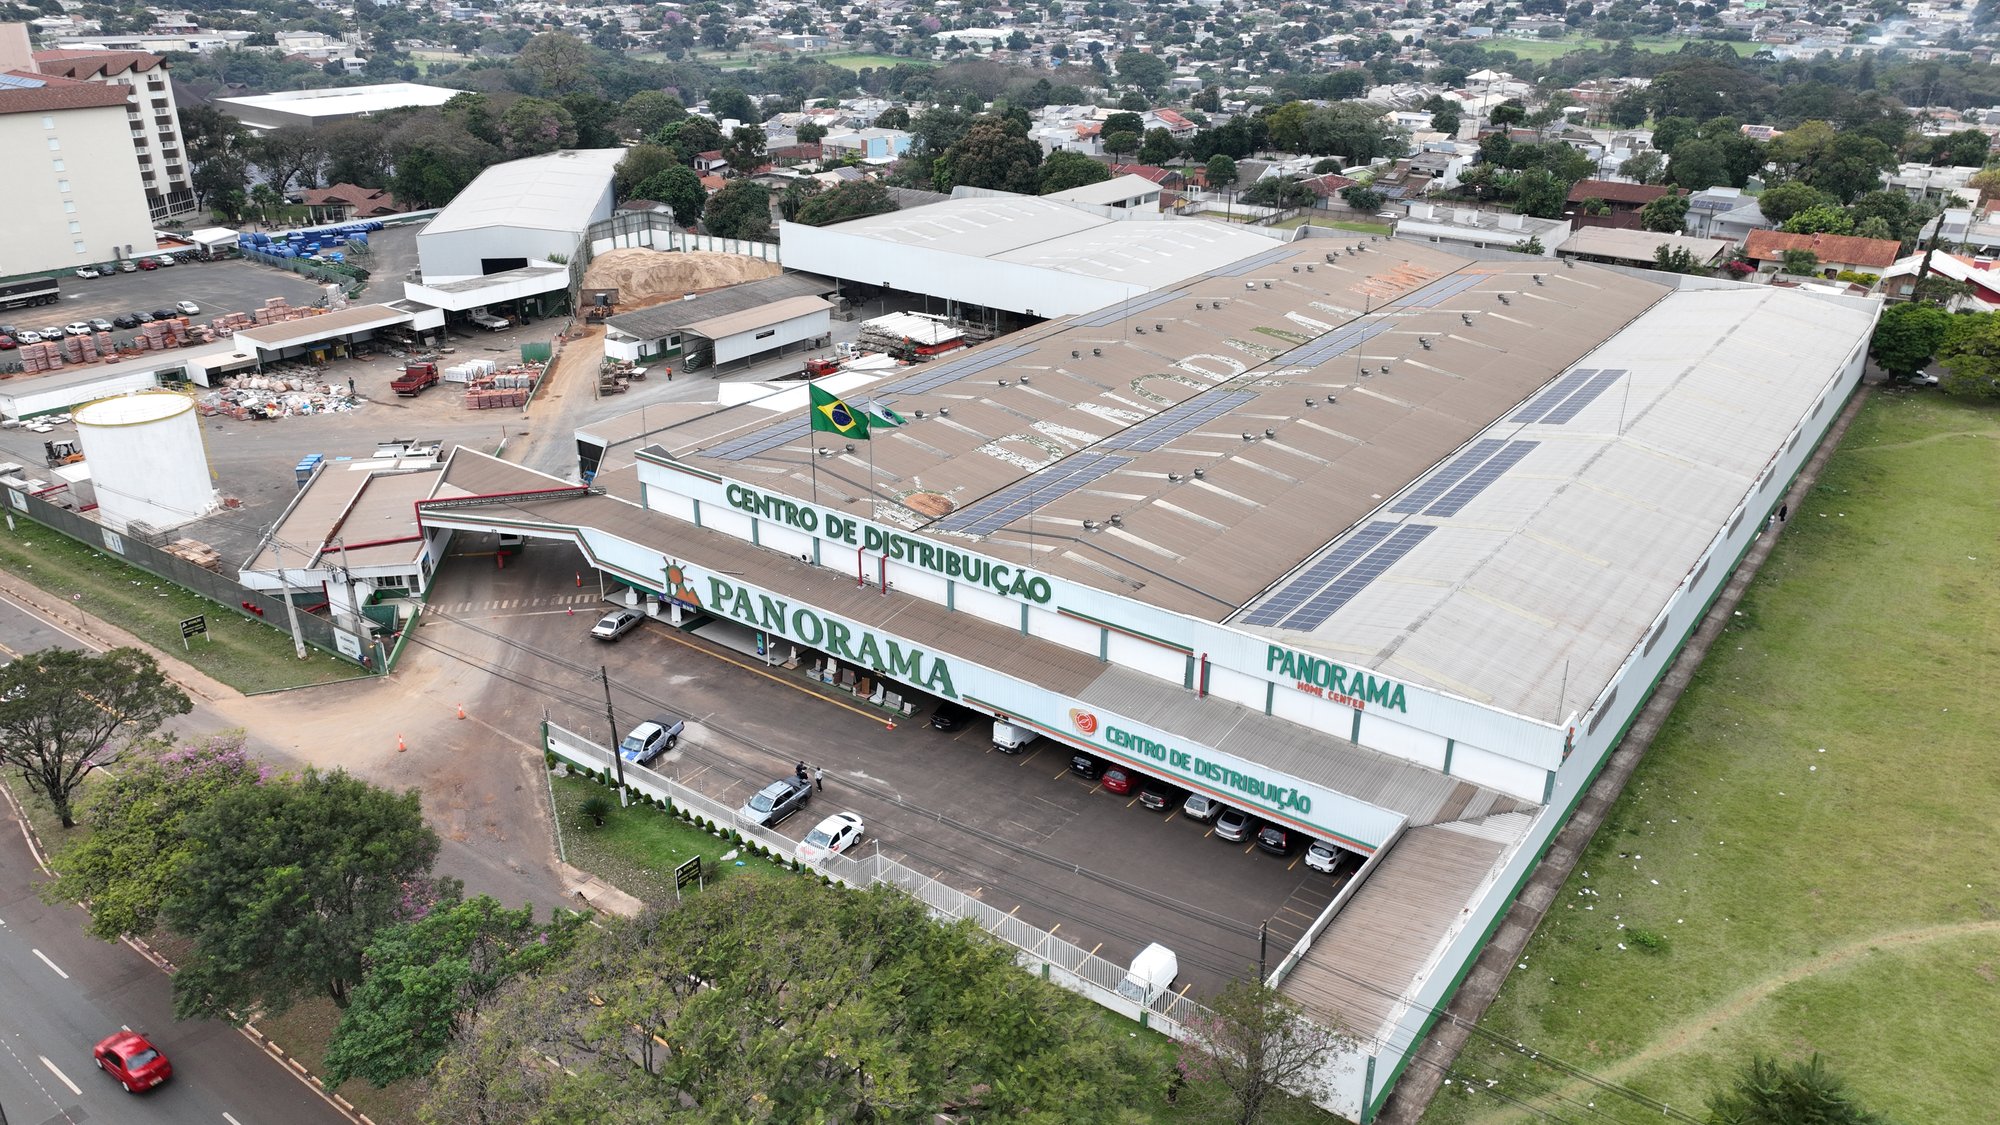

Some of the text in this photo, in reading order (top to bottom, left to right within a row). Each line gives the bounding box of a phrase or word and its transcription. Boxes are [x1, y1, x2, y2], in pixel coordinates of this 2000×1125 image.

[726, 484, 1051, 604] CENTRO DE DISTRIBUIÇÃO
[707, 576, 958, 699] PANORAMA
[1266, 644, 1407, 713] PANORAMA
[1297, 681, 1365, 710] HOME CENTER
[1105, 725, 1312, 814] CENTRO DE DISTRIBUIÇÃO
